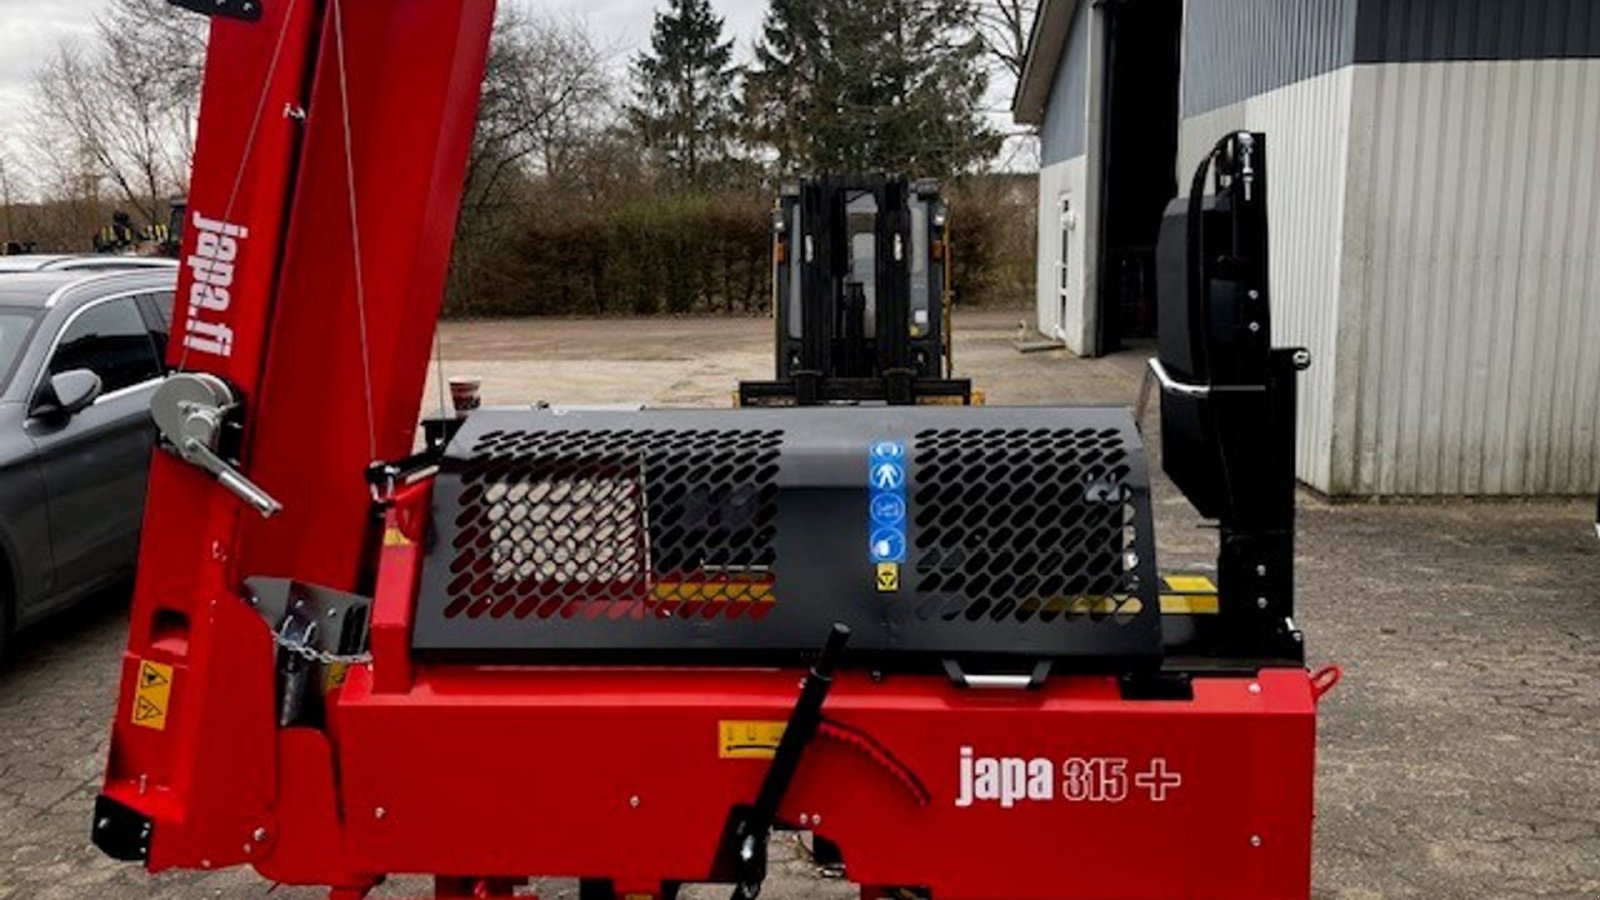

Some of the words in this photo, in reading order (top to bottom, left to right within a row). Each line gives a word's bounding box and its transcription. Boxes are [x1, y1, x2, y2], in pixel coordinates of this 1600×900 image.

[183, 210, 248, 358] japa.fi
[955, 746, 1053, 808] japa
[1062, 757, 1128, 802] 315
